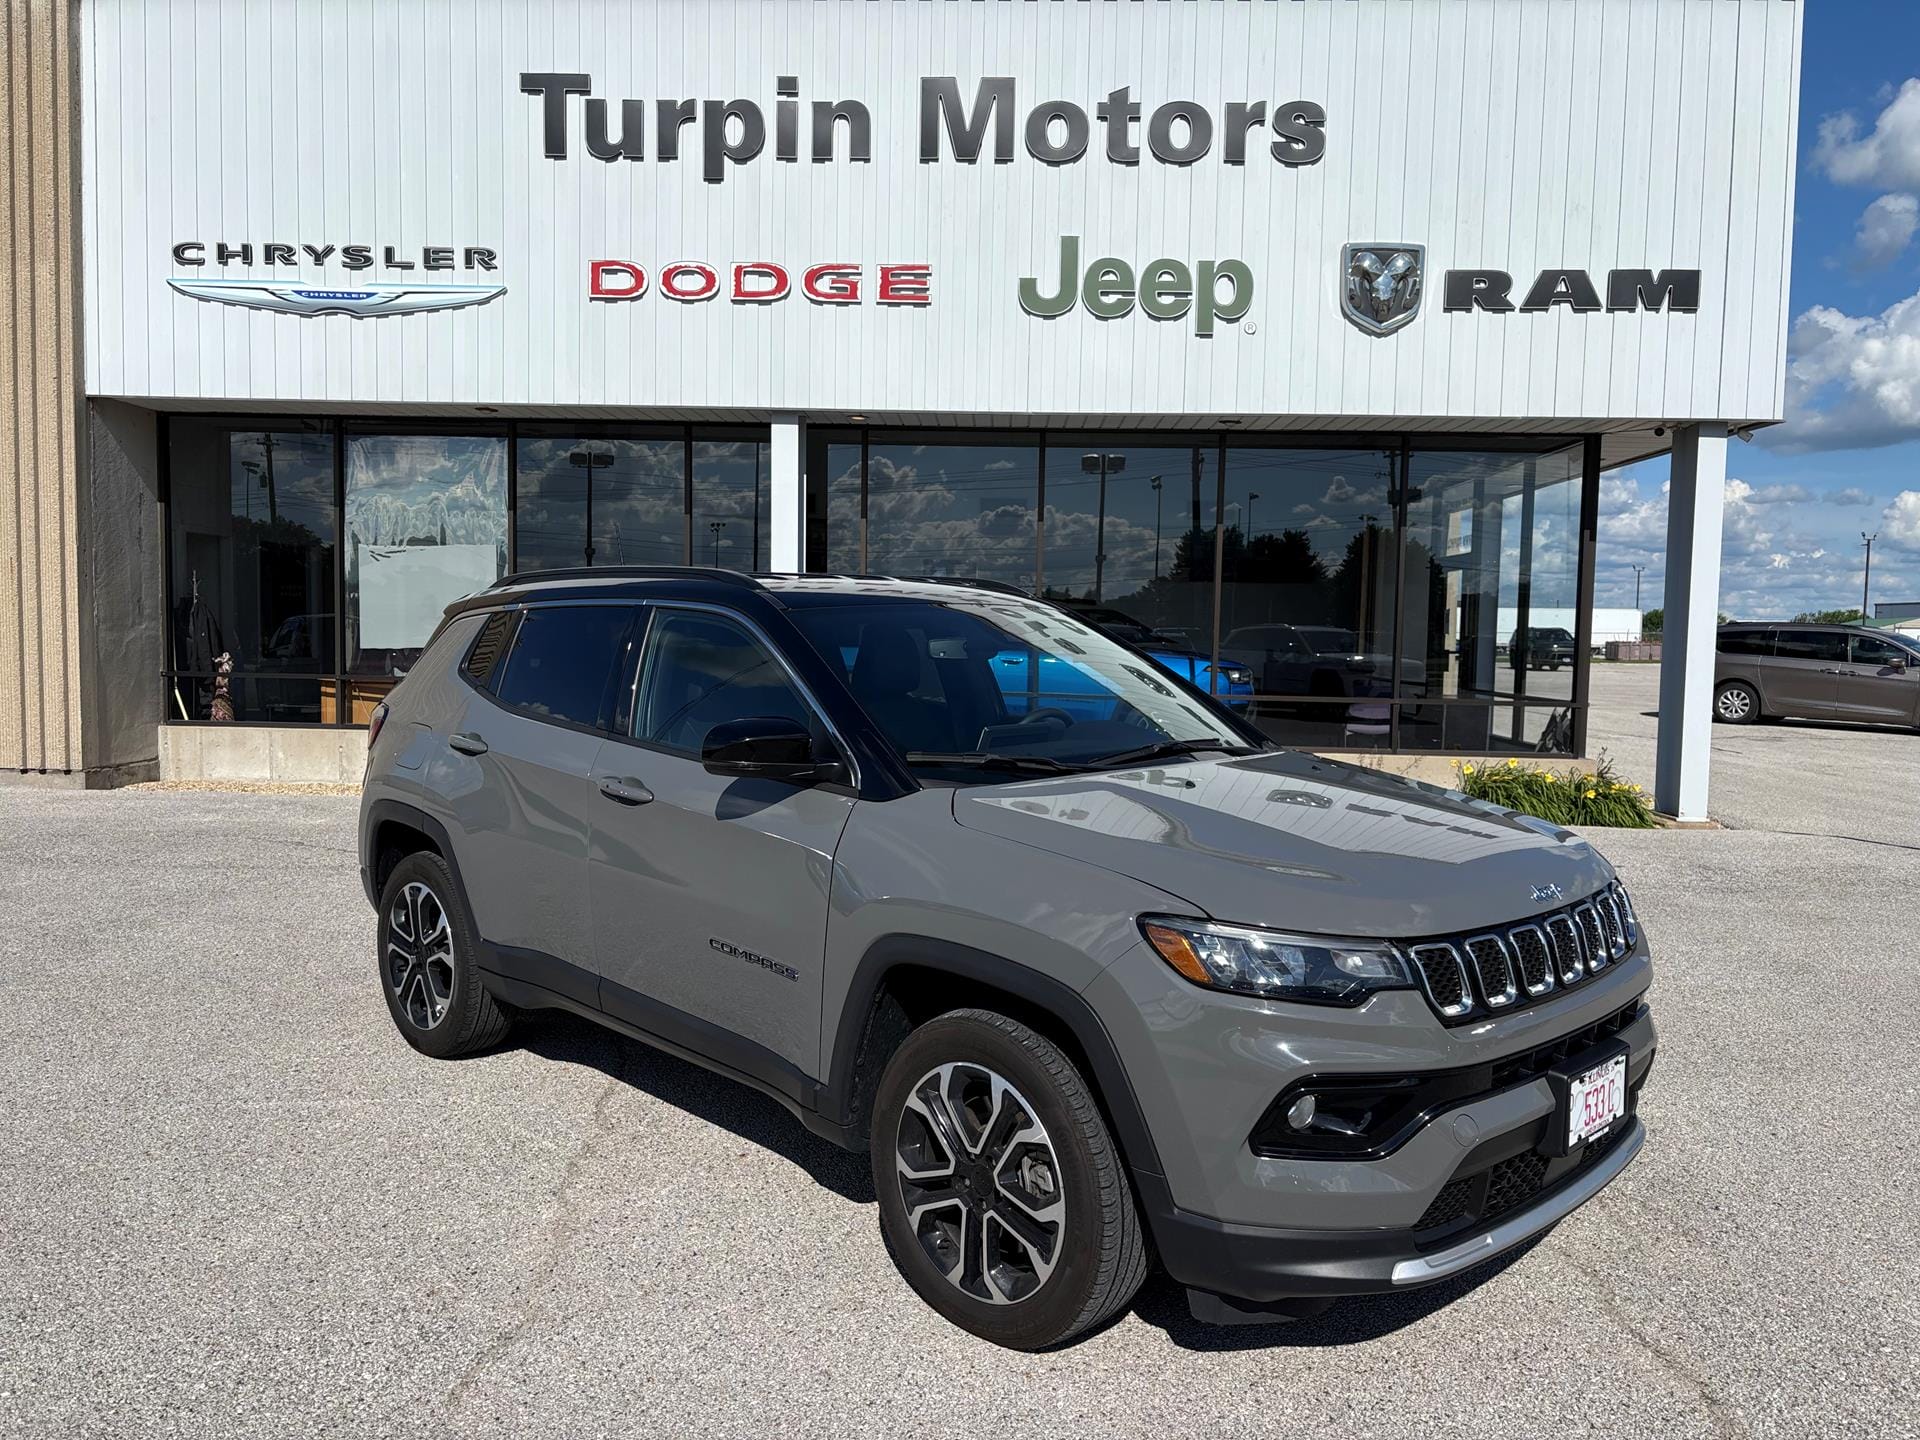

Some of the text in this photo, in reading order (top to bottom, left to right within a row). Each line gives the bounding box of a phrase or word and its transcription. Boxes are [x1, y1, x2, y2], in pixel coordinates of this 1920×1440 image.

[521, 73, 1327, 183] Turpin Motors
[172, 242, 498, 271] CHRYSLER
[301, 291, 368, 299] CHRYSLER
[589, 259, 934, 305] DODGE
[1018, 237, 1254, 337] Jeep
[1445, 269, 1702, 313] RAM
[709, 938, 800, 982] COMPASS
